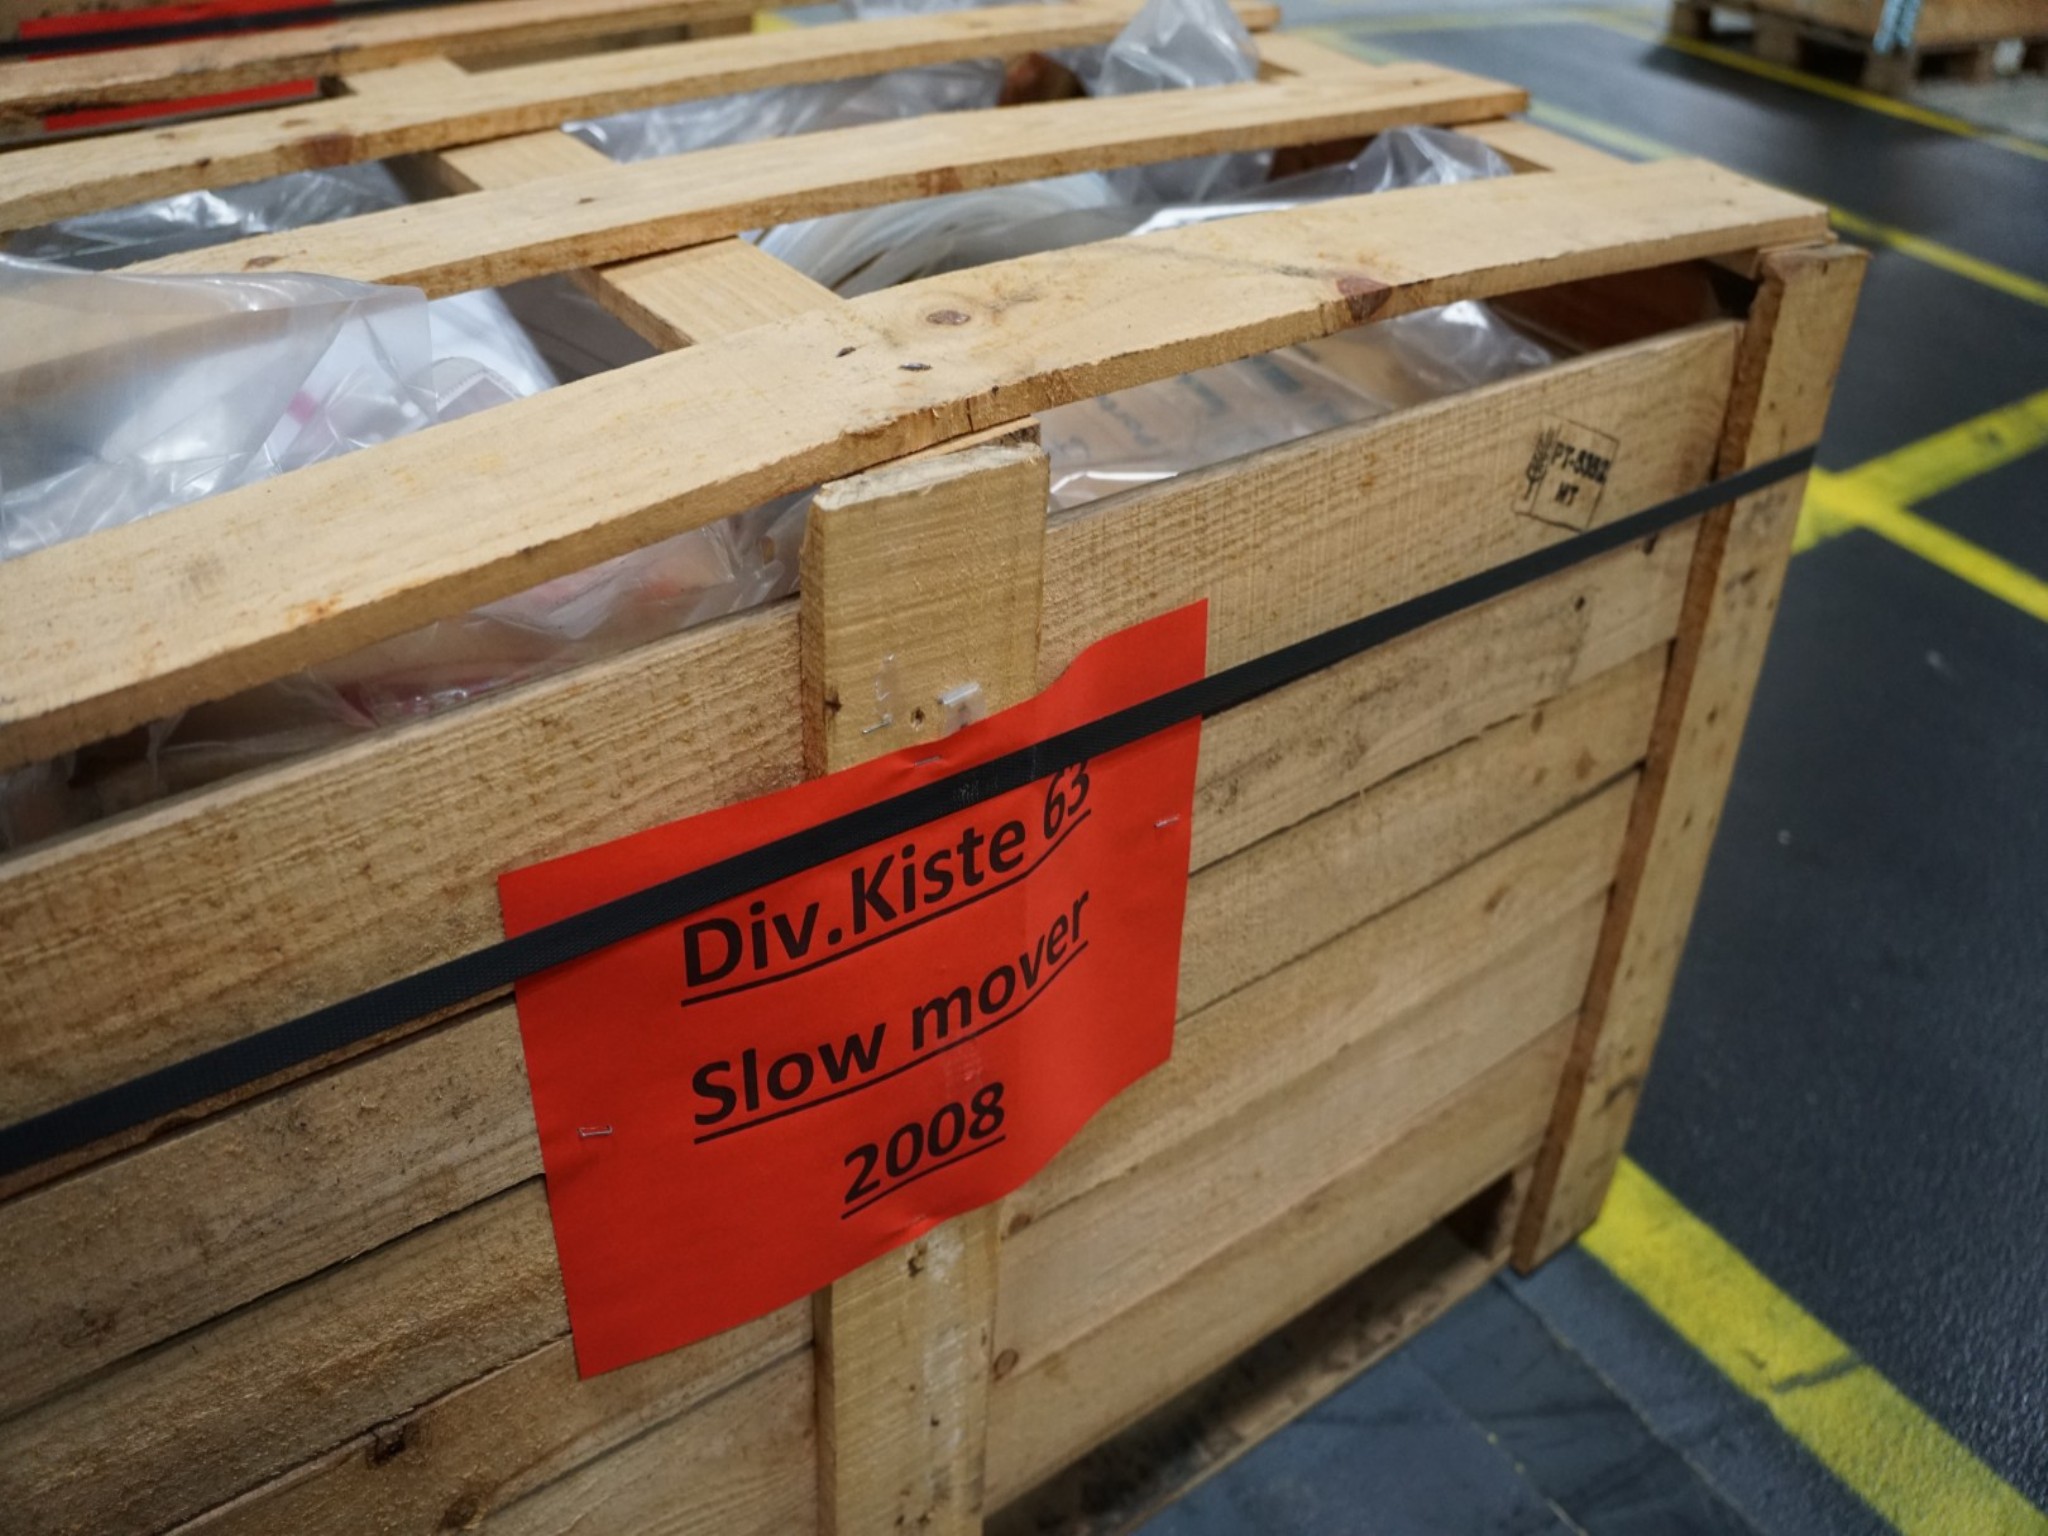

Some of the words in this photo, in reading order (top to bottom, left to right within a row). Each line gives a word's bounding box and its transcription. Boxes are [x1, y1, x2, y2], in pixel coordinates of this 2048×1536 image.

[1043, 759, 1090, 840] 63
[691, 1022, 887, 1126] Slow
[911, 890, 1089, 1052] mover
[844, 1081, 1006, 1206] 2008
